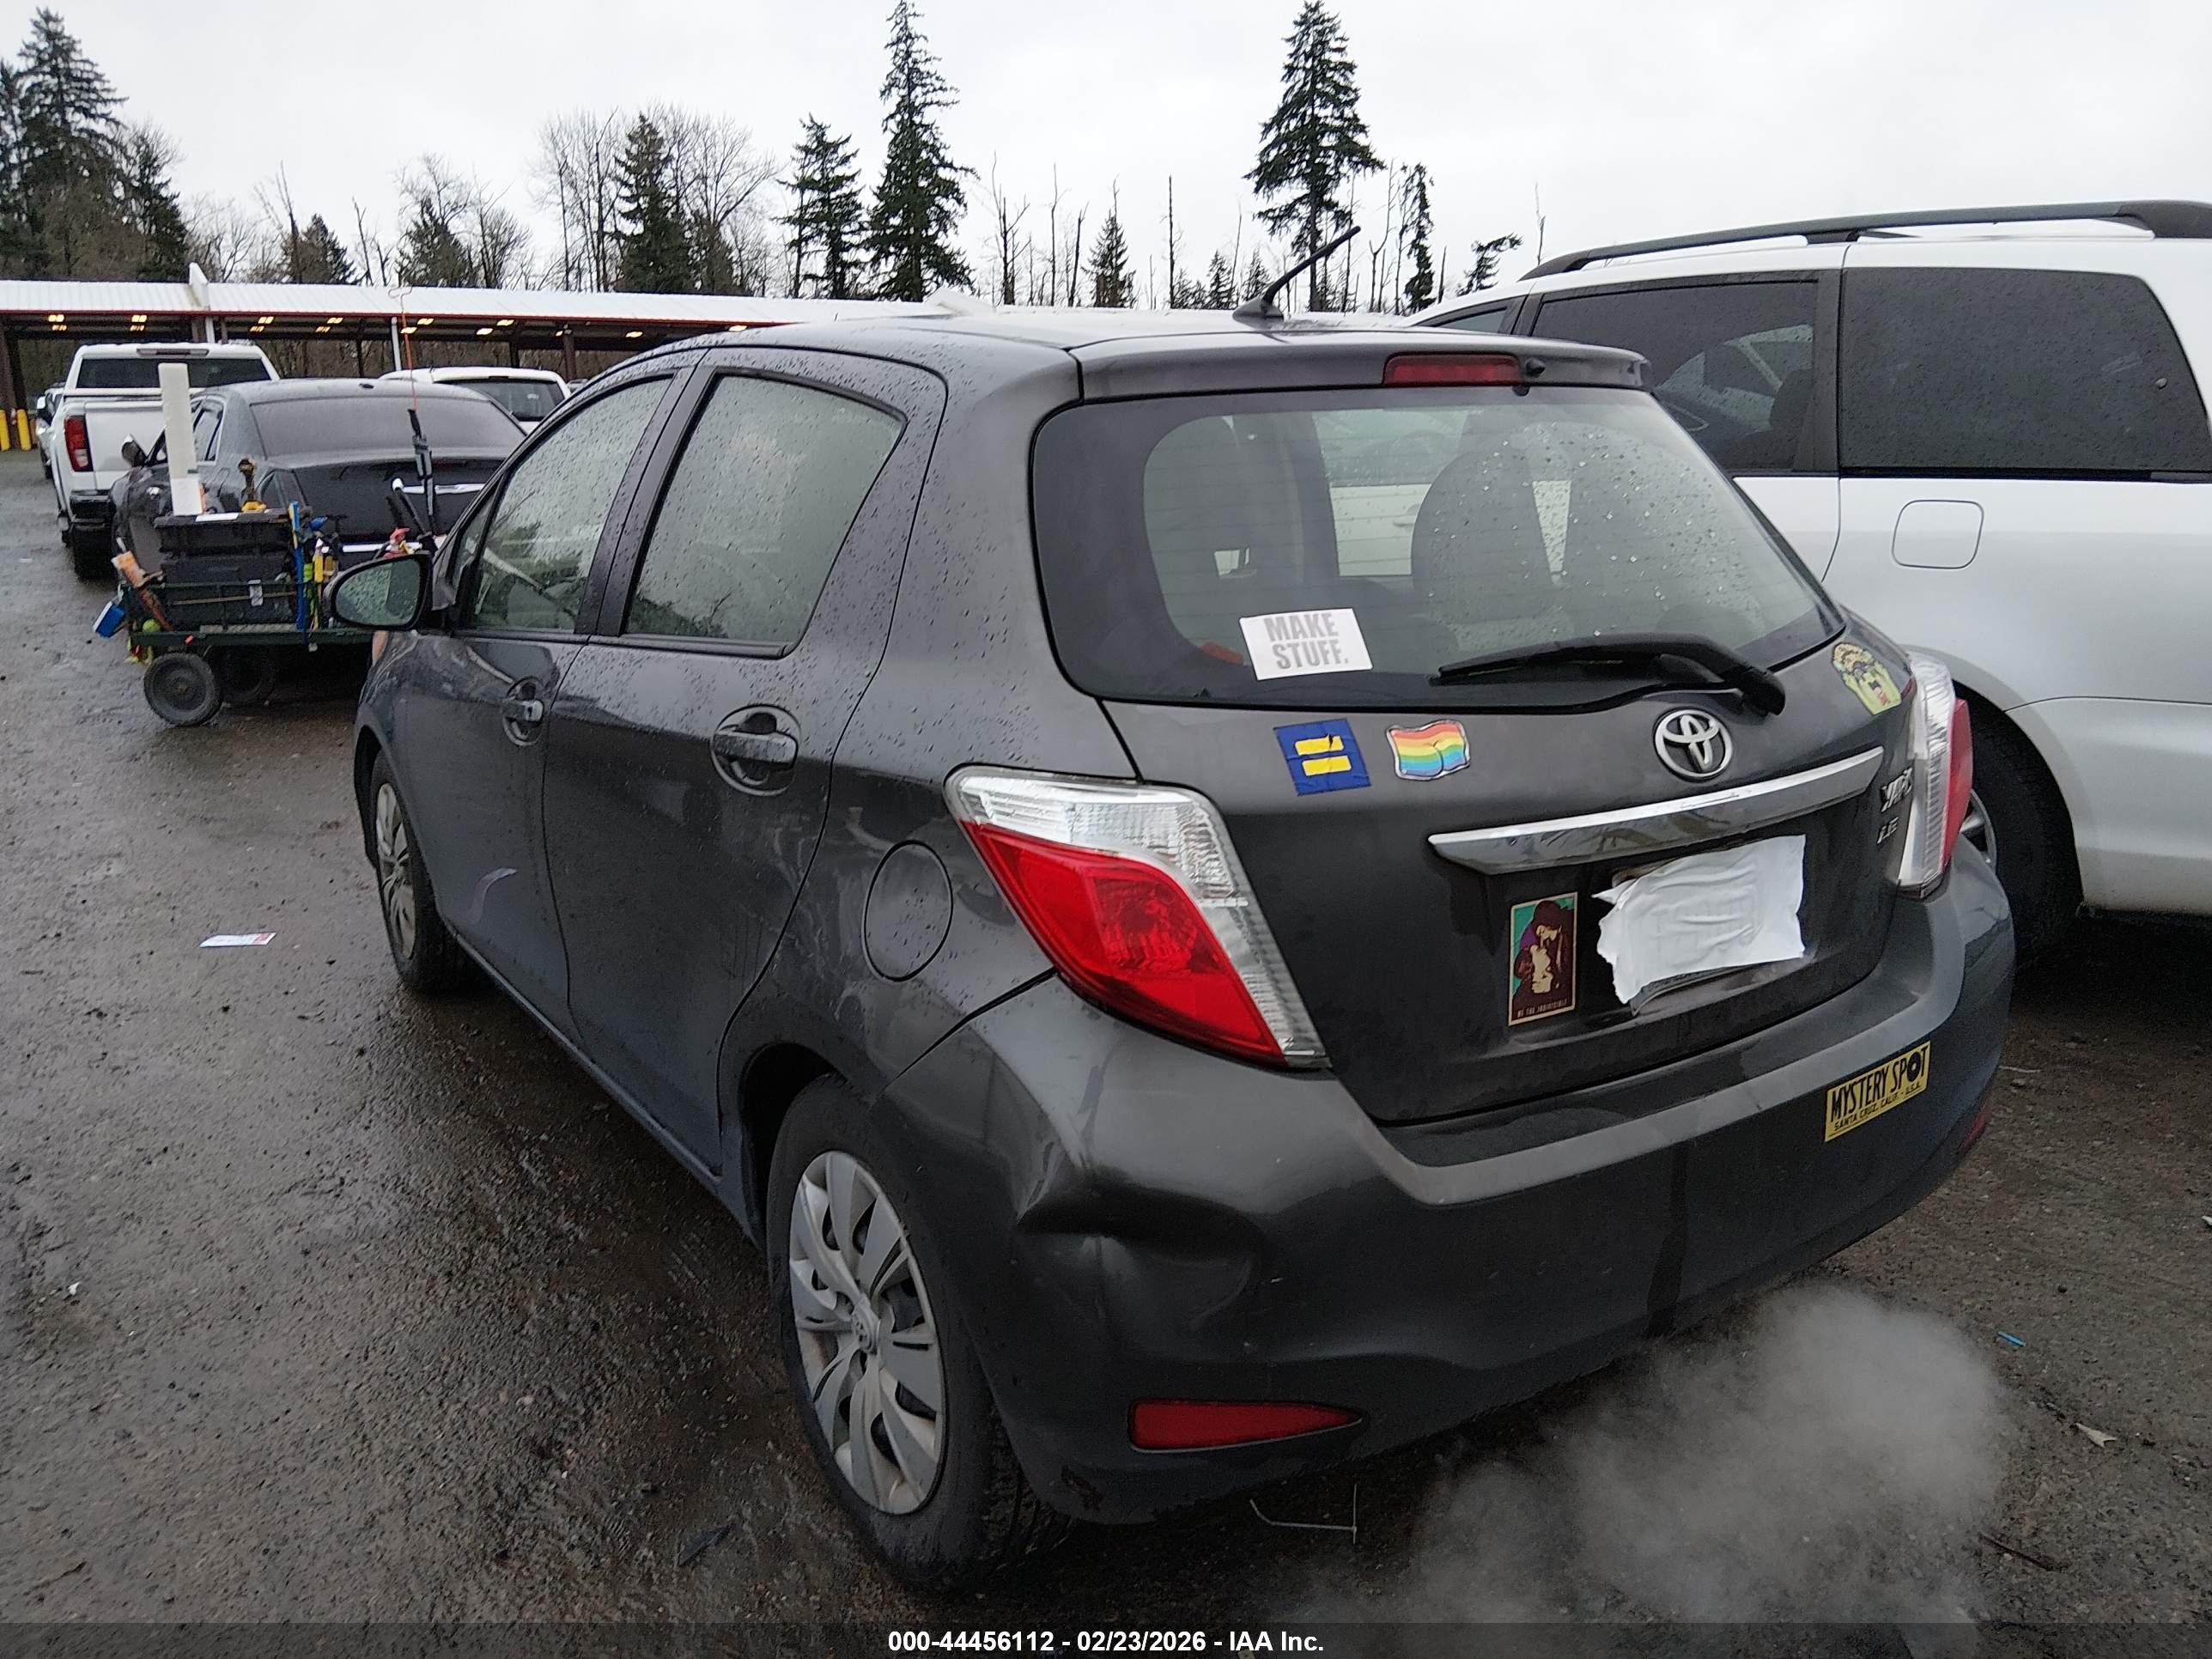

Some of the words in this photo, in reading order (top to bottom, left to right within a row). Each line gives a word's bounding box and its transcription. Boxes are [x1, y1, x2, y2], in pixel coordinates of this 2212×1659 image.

[1264, 613, 1340, 641] MAKE
[1272, 639, 1349, 669] STUFF.
[1830, 1065, 1890, 1122] MYSTERY
[1890, 1045, 1929, 1092] SPOT
